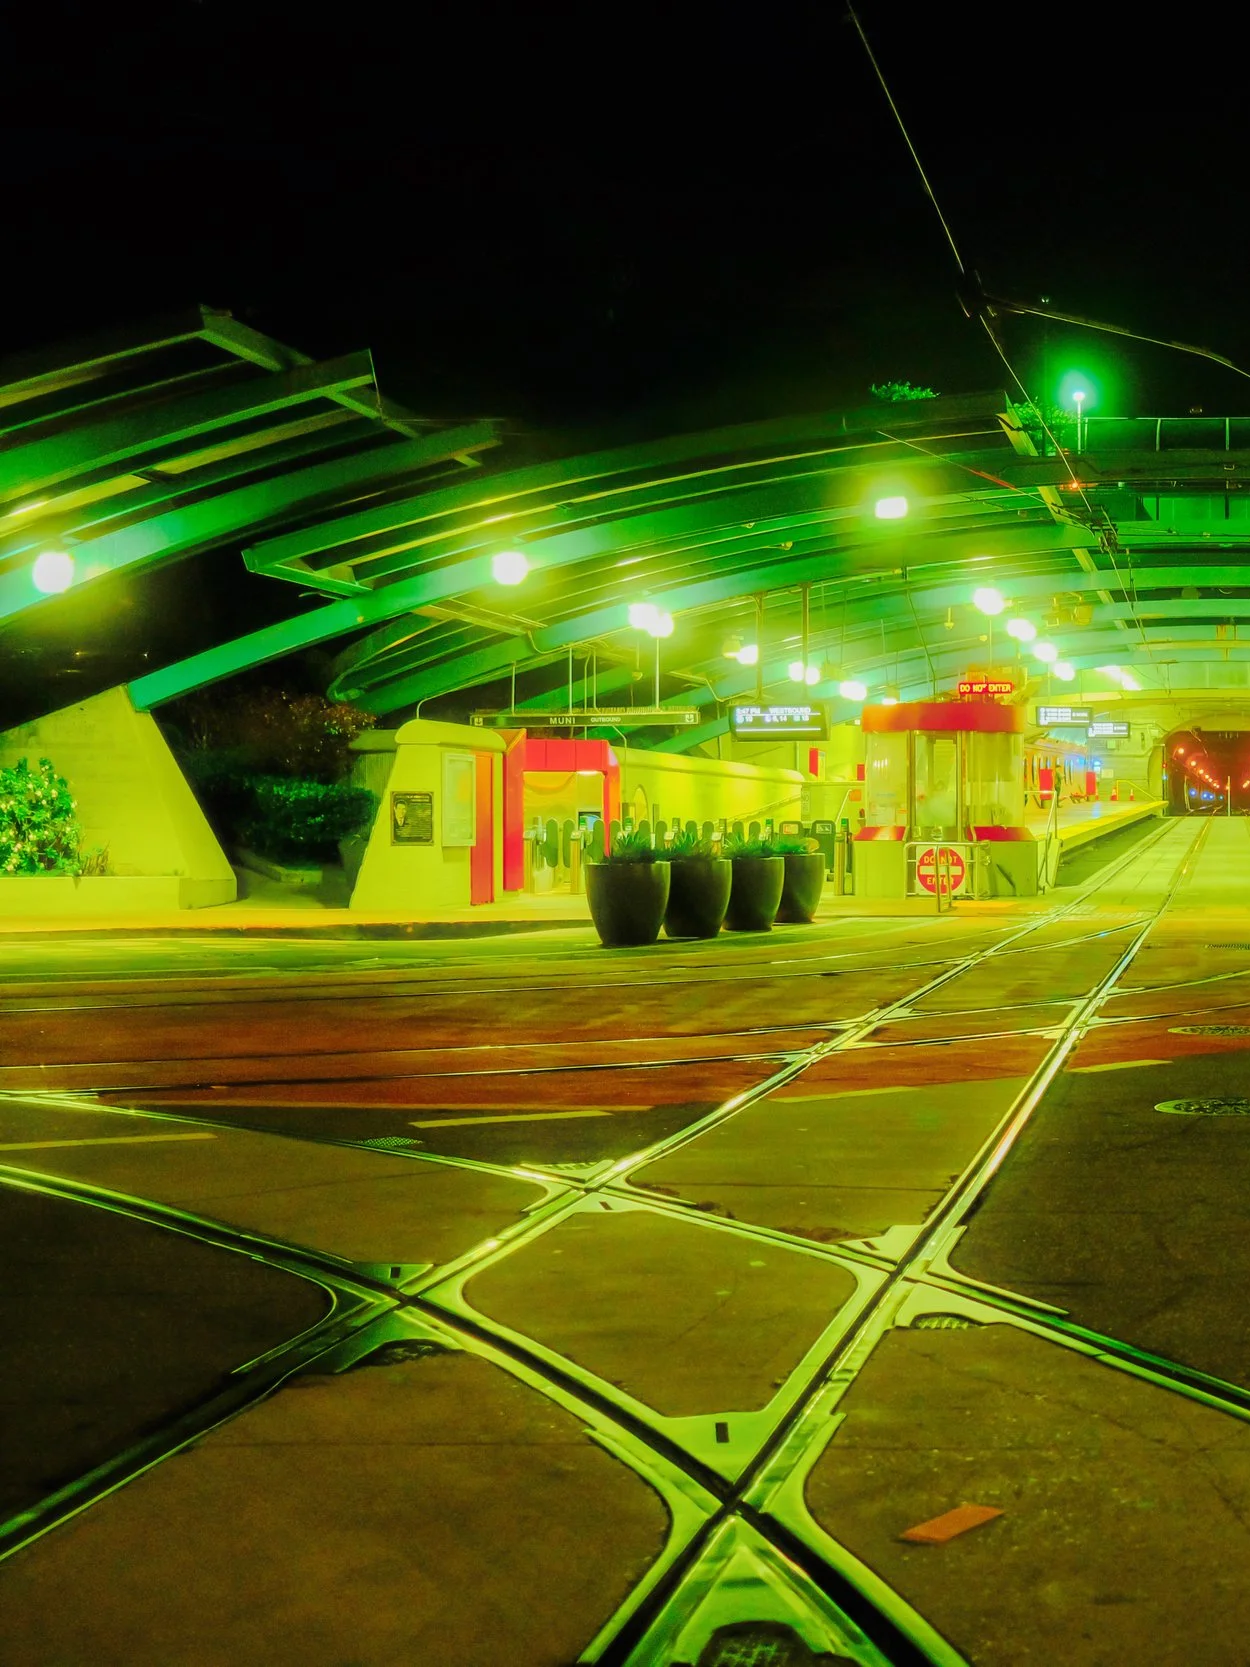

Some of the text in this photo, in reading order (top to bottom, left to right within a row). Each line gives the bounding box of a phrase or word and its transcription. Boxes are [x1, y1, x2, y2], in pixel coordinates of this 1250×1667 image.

[960, 684, 970, 692] DO
[989, 684, 1011, 692] ENTER
[549, 717, 576, 725] MUNI
